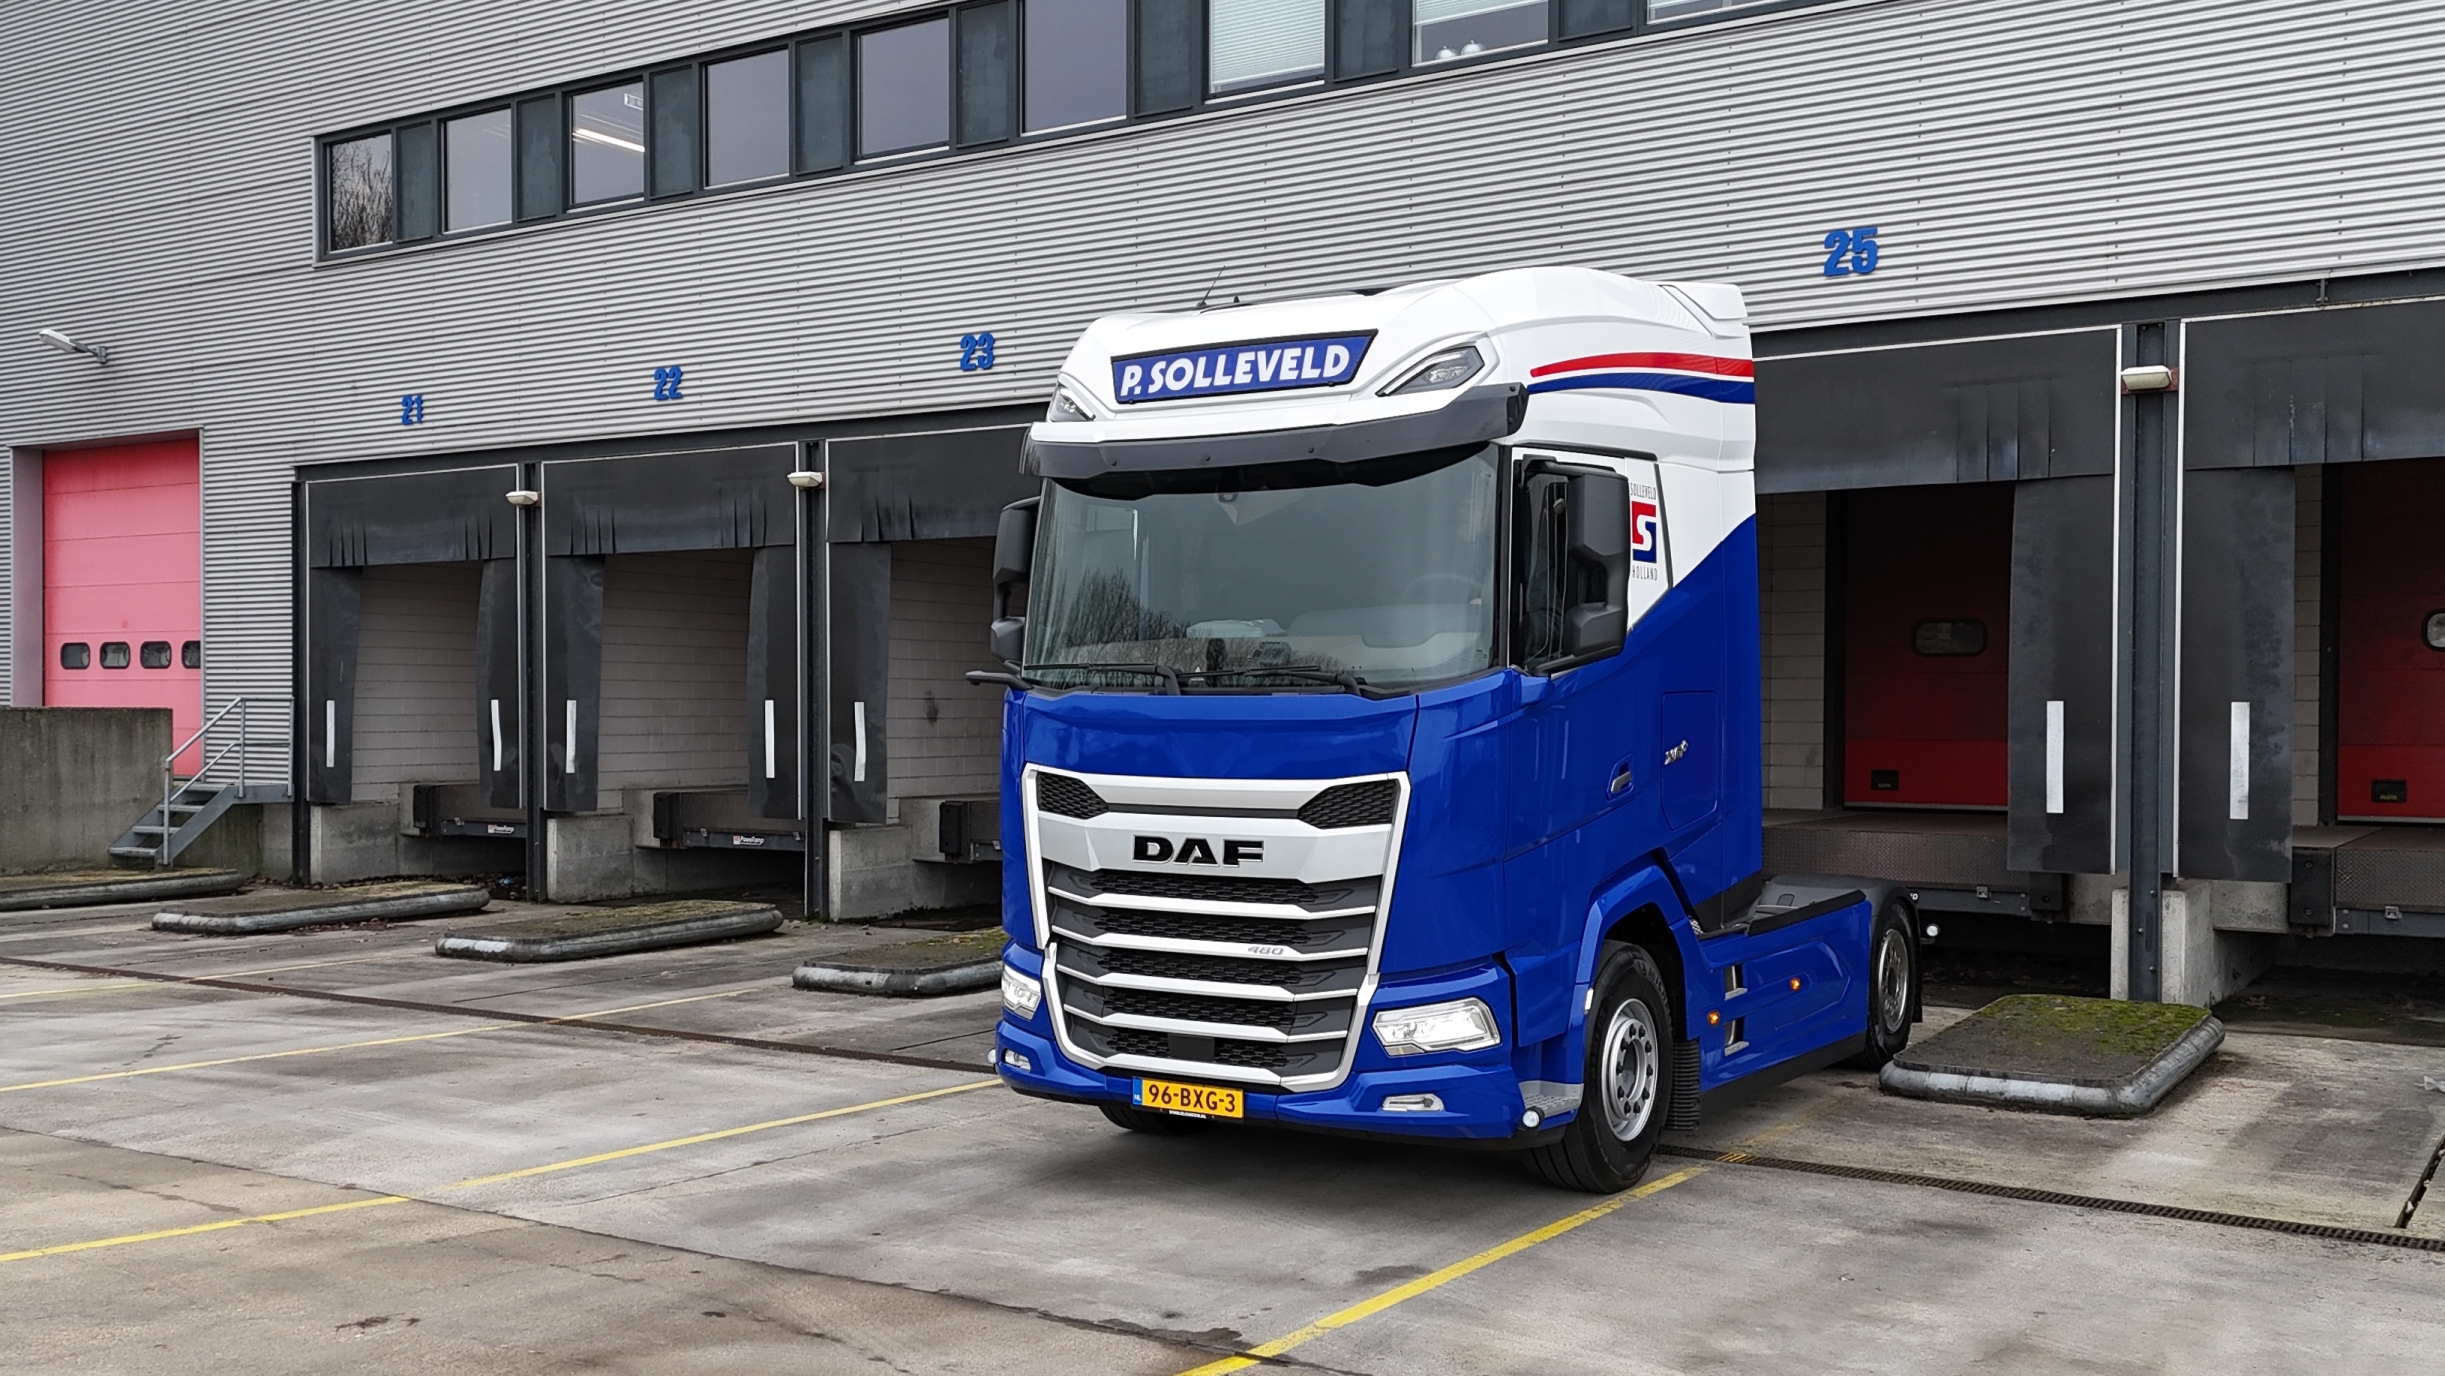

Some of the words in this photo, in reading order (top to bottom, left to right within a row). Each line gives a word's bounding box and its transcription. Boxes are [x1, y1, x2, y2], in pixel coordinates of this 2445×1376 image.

[1824, 227, 1878, 277] 25
[960, 332, 995, 371] 23
[654, 365, 683, 401] 22
[1148, 345, 1350, 393] SOLLEVELD
[401, 393, 423, 425] 21
[1630, 482, 1656, 500] SOLLEVELD
[1632, 565, 1657, 581] HOLLAND
[1132, 834, 1263, 868] DAF
[1248, 946, 1284, 955] 480
[1148, 1084, 1235, 1112] 96-BXG-3
